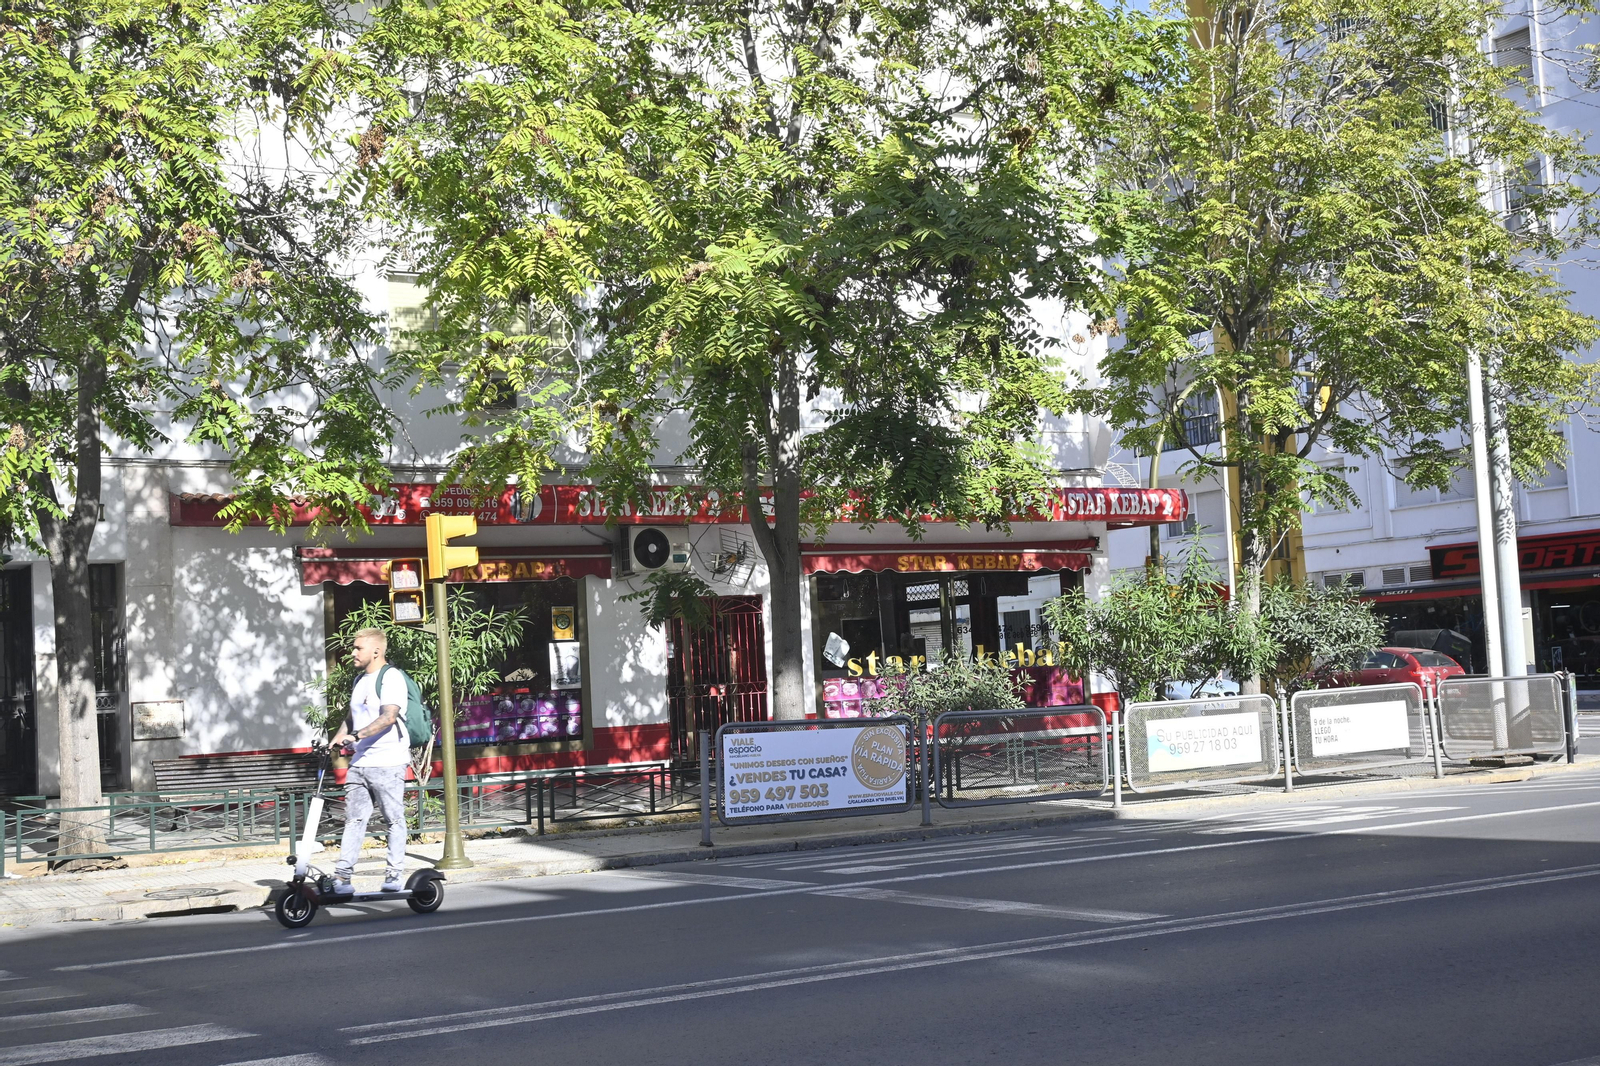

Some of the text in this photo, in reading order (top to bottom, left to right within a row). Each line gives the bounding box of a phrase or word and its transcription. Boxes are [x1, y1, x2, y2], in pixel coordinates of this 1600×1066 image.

[1067, 492, 1107, 516] STAR
[1108, 492, 1160, 516] KEBAP
[1162, 493, 1174, 516] 2
[478, 511, 498, 521] 474
[462, 561, 545, 580] KEBAP
[897, 554, 947, 571] STAR
[957, 554, 1020, 570] KEBAP
[847, 650, 926, 677] star
[1313, 718, 1318, 726] 9
[1333, 716, 1351, 724] noche.
[731, 737, 755, 746] VIALE
[863, 727, 903, 755] SIN EXCLUSIVA
[1175, 726, 1229, 741] PUBLICIDAD
[1315, 734, 1338, 744] TU HORA
[728, 744, 762, 755] espacio
[871, 741, 893, 755] PLAN
[1169, 738, 1238, 755] 959 27 18 03
[766, 759, 796, 767] DESEOS
[854, 745, 903, 772] VÍA RÁPIDA
[729, 766, 847, 786] ¿VENDES TU CASA?
[857, 763, 892, 785] TARIFA FIJA
[729, 783, 829, 804] 959 497 503
[729, 800, 830, 814] TELÉFONO PARA VENDEDORES
